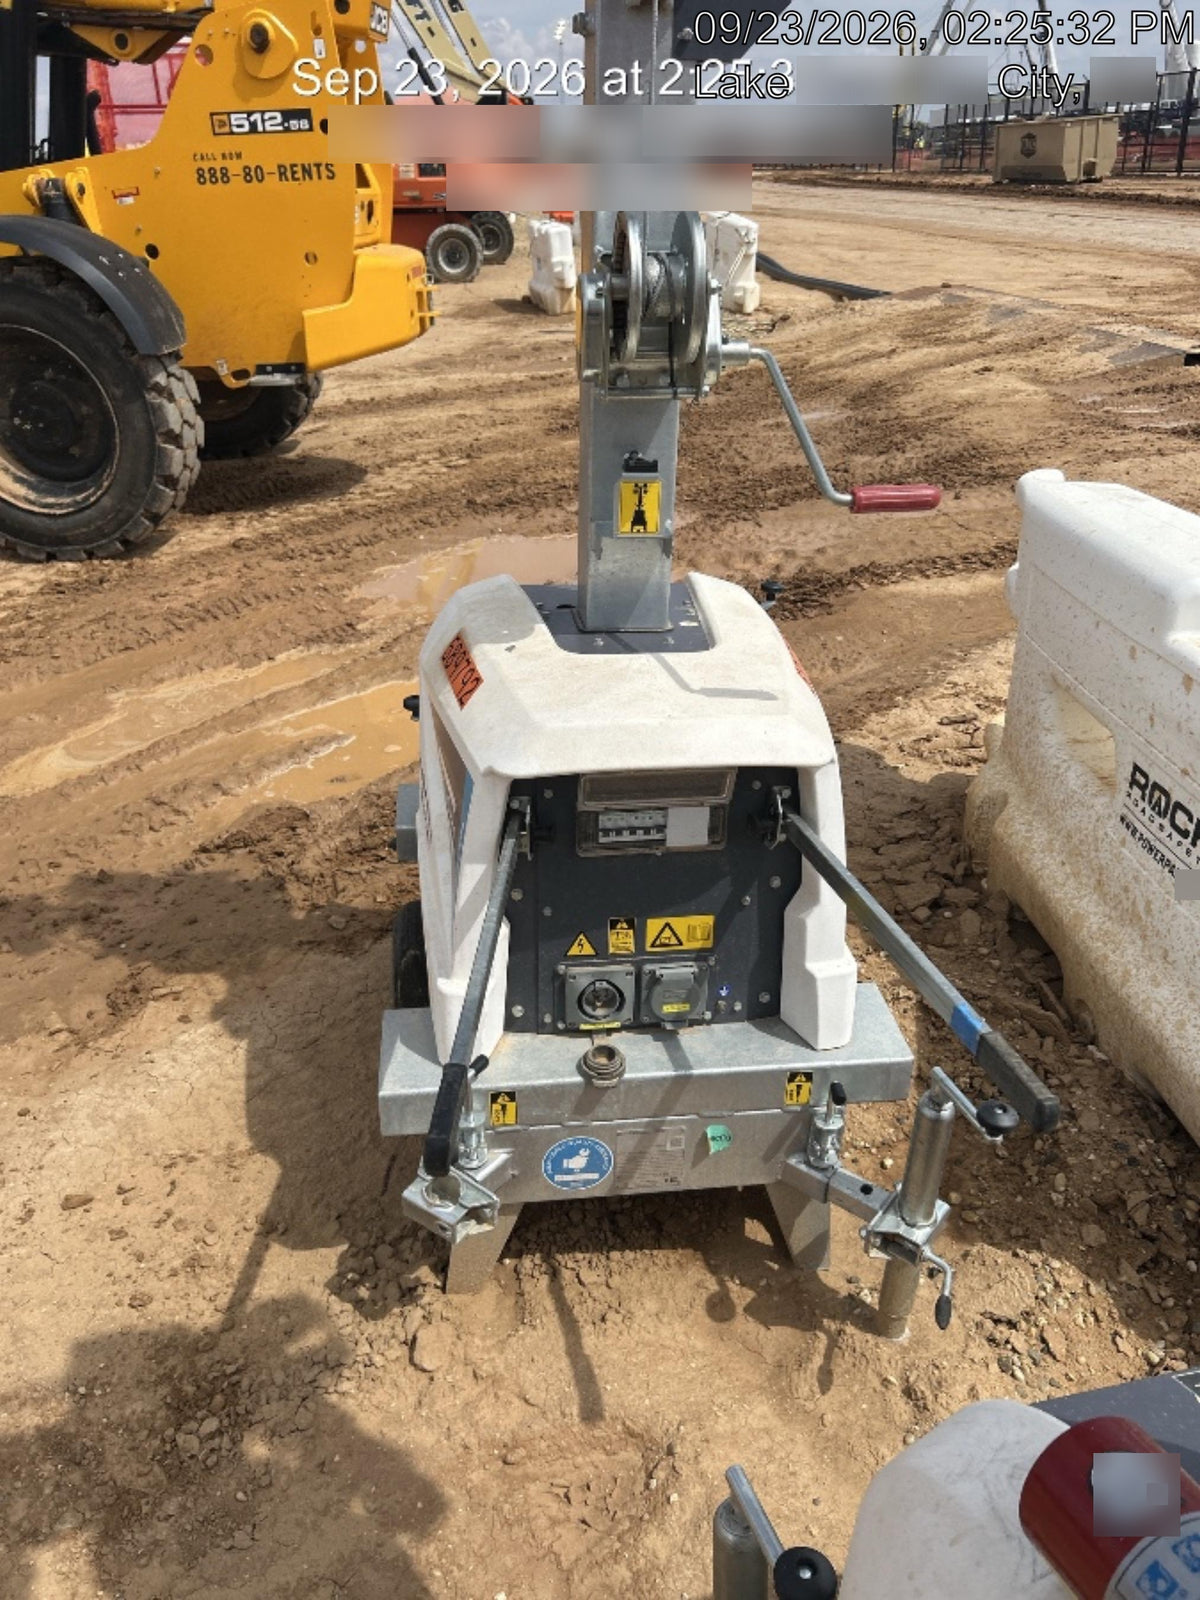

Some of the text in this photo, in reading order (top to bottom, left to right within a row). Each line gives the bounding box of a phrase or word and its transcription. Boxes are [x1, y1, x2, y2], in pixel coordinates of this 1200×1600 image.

[193, 151, 243, 162] CALL NOW
[196, 162, 336, 185] 888-80-RENTS
